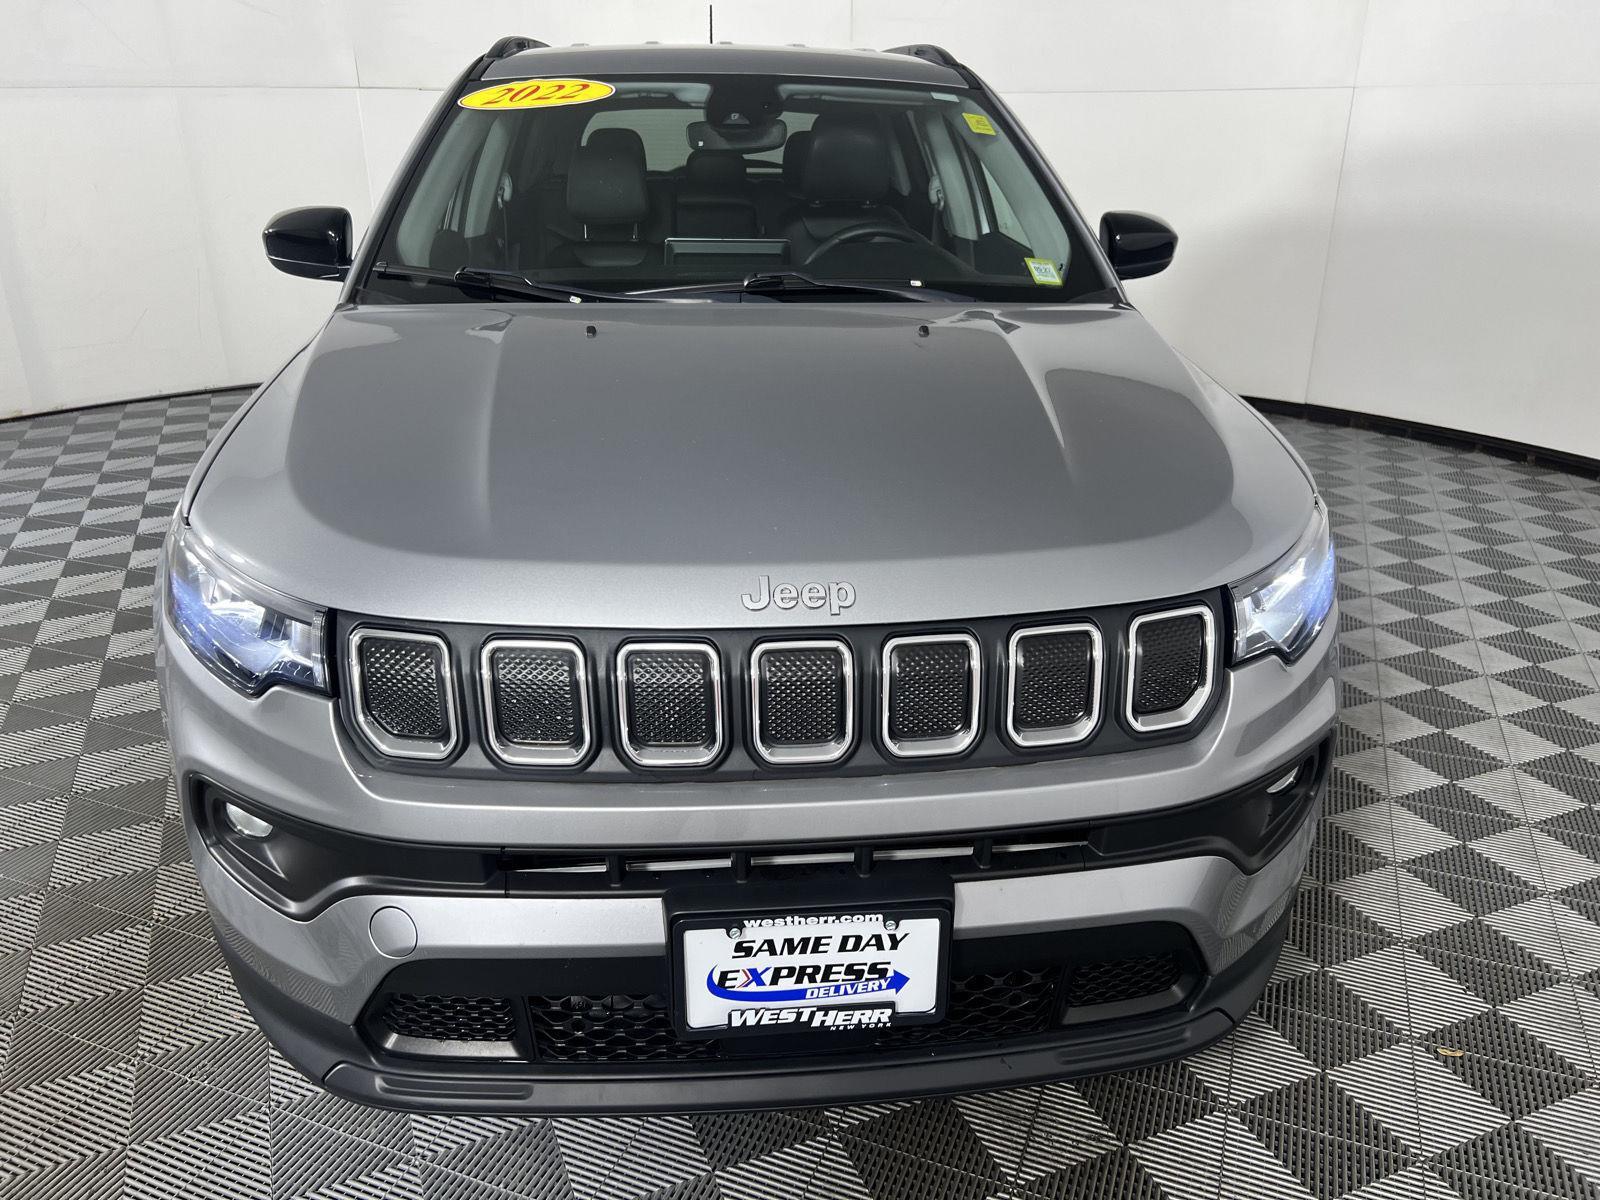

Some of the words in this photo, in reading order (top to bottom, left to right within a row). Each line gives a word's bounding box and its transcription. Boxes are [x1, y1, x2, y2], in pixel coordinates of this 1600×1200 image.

[480, 83, 591, 106] 2022
[740, 575, 857, 616] Jeep
[743, 913, 884, 929] westherr.com
[731, 935, 833, 959] SAME
[837, 932, 911, 953] DAY
[716, 961, 892, 989] EXPRESS
[805, 977, 892, 999] DELIVERY
